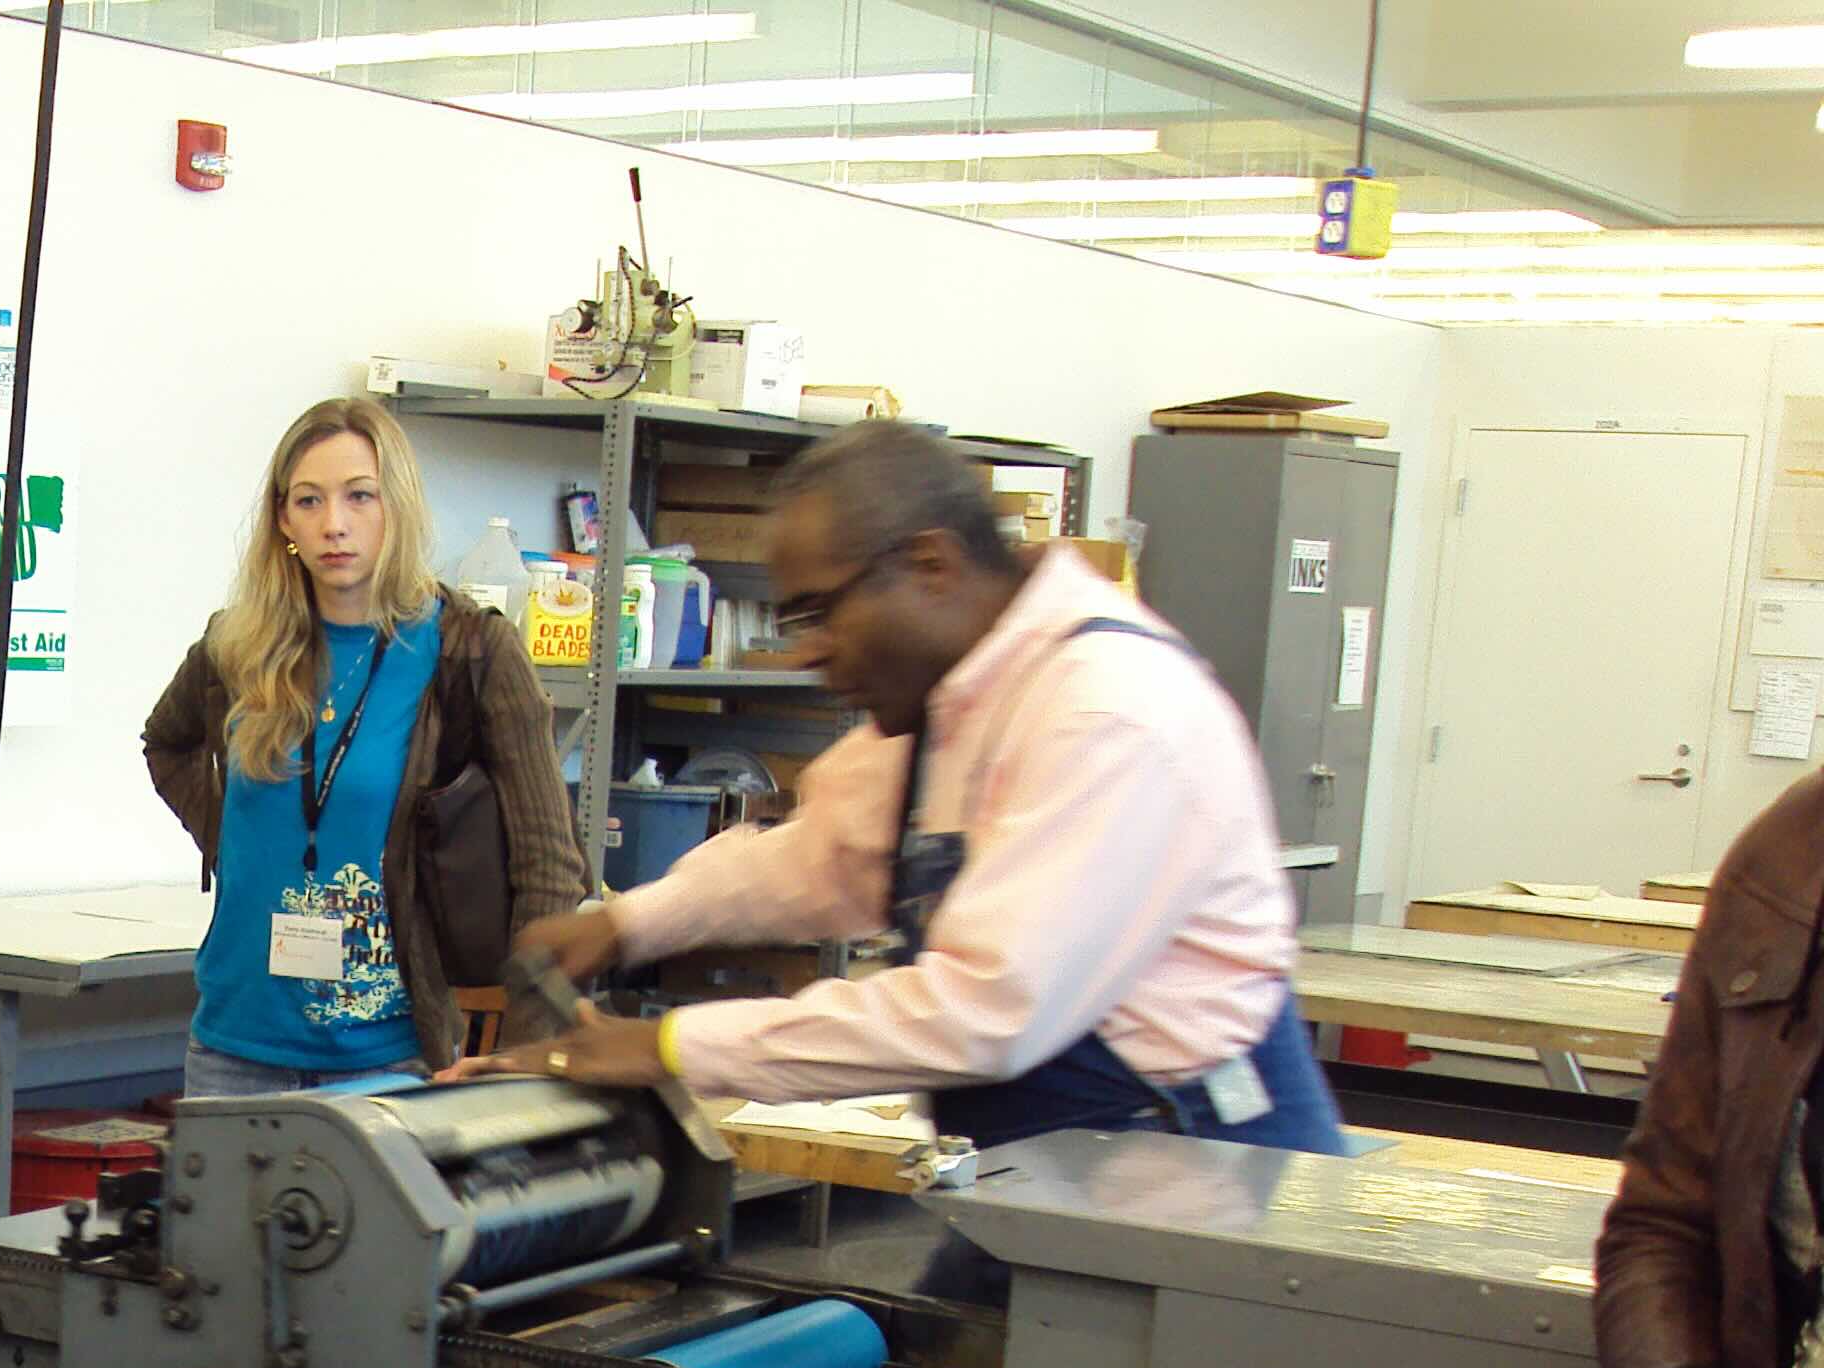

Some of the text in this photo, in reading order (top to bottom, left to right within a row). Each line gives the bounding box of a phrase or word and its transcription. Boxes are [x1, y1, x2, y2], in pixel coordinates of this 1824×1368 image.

[1291, 558, 1325, 587] INKS
[34, 632, 66, 652] Aid
[540, 623, 587, 641] DEAD
